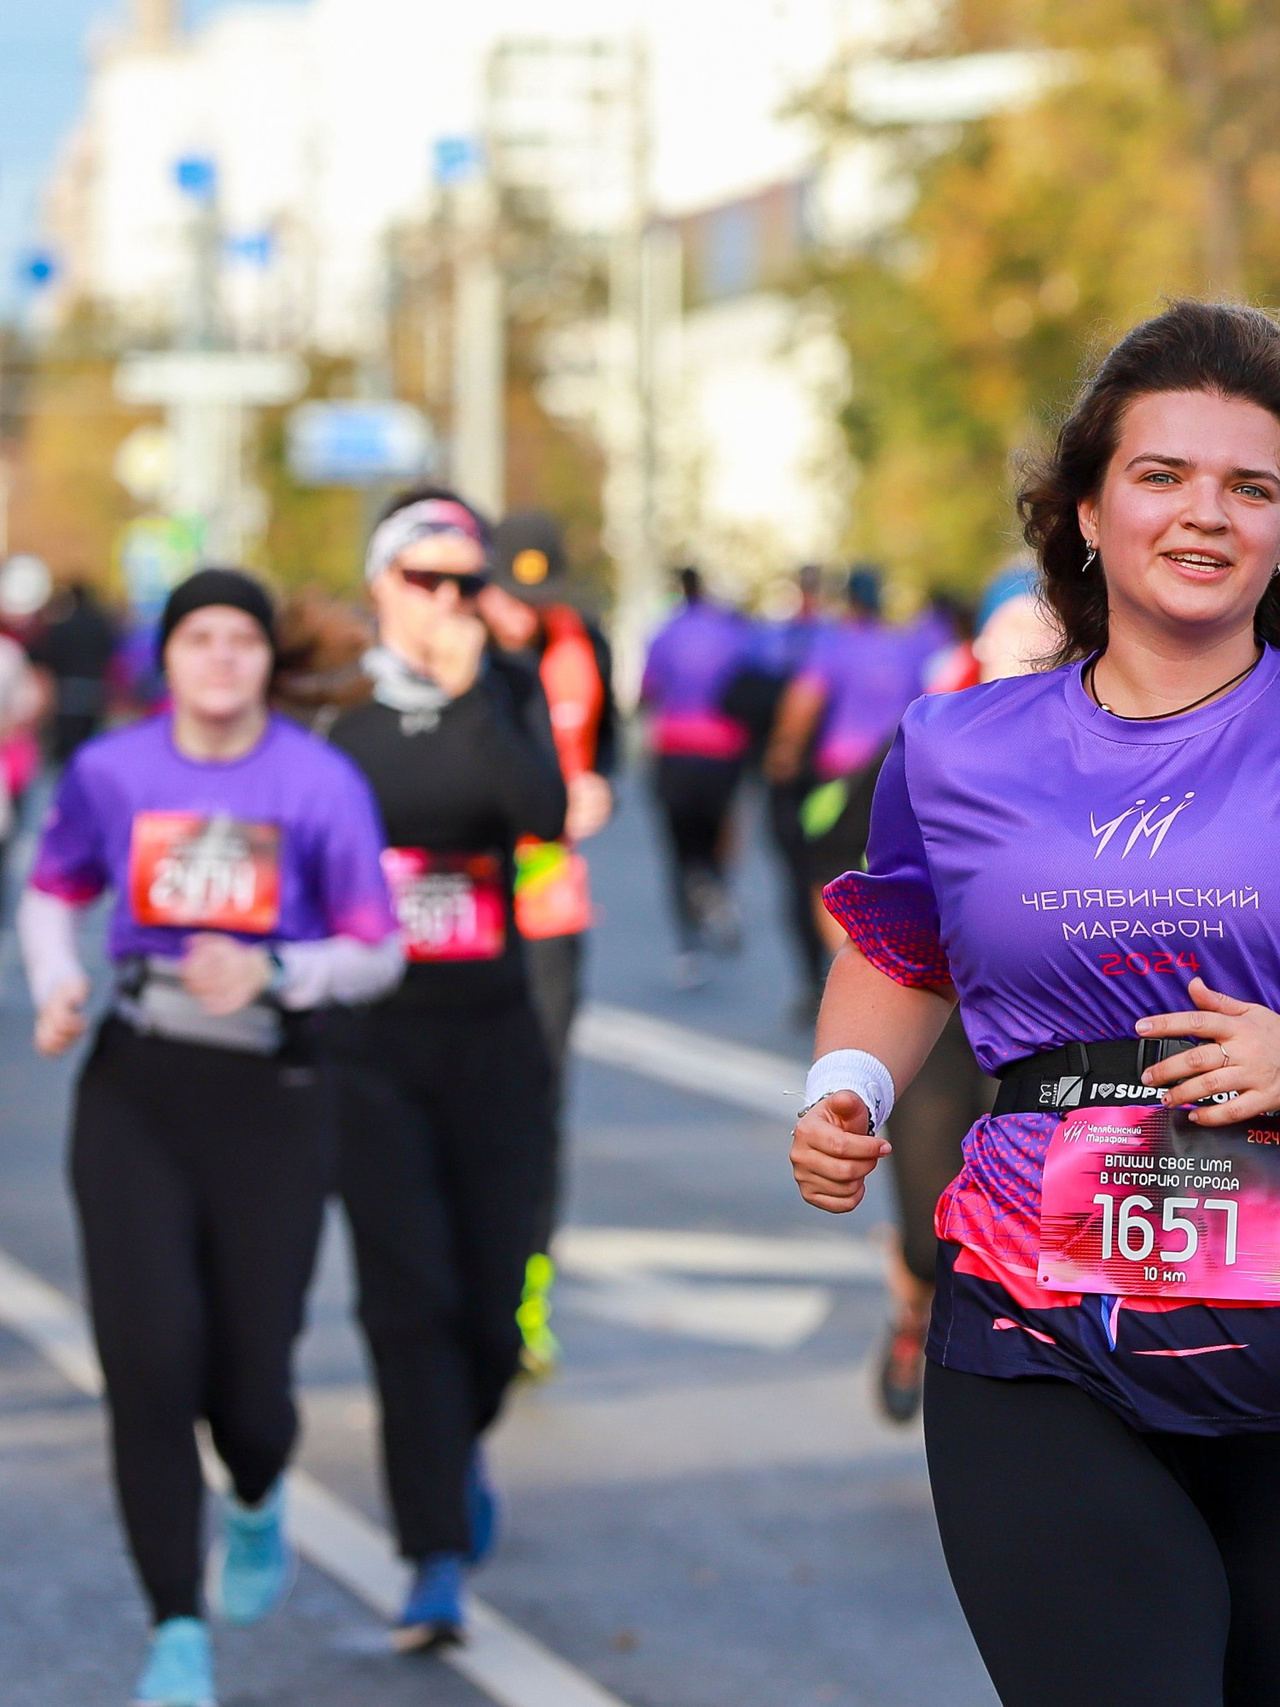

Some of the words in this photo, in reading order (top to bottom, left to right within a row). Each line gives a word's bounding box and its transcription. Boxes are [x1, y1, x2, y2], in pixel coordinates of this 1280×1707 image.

[1021, 886, 1260, 911] ЧЕЛЯБИНСКИЙ
[1061, 919, 1224, 941] МАРАФОН
[1099, 951, 1201, 976] 2024
[1085, 1133, 1128, 1145] Марафон
[1087, 1124, 1142, 1135] Челябинский
[1247, 1129, 1280, 1146] 2024
[1104, 1154, 1154, 1169] ВПИШИ
[1158, 1157, 1195, 1170] СВОЕ
[1200, 1159, 1232, 1173] ИМЯ
[1099, 1171, 1109, 1184] В
[1113, 1172, 1180, 1187] ИСТОРИЮ
[1184, 1175, 1240, 1191] ГОРОДА
[1093, 1193, 1239, 1265] 1657
[1143, 1266, 1158, 1281] 10
